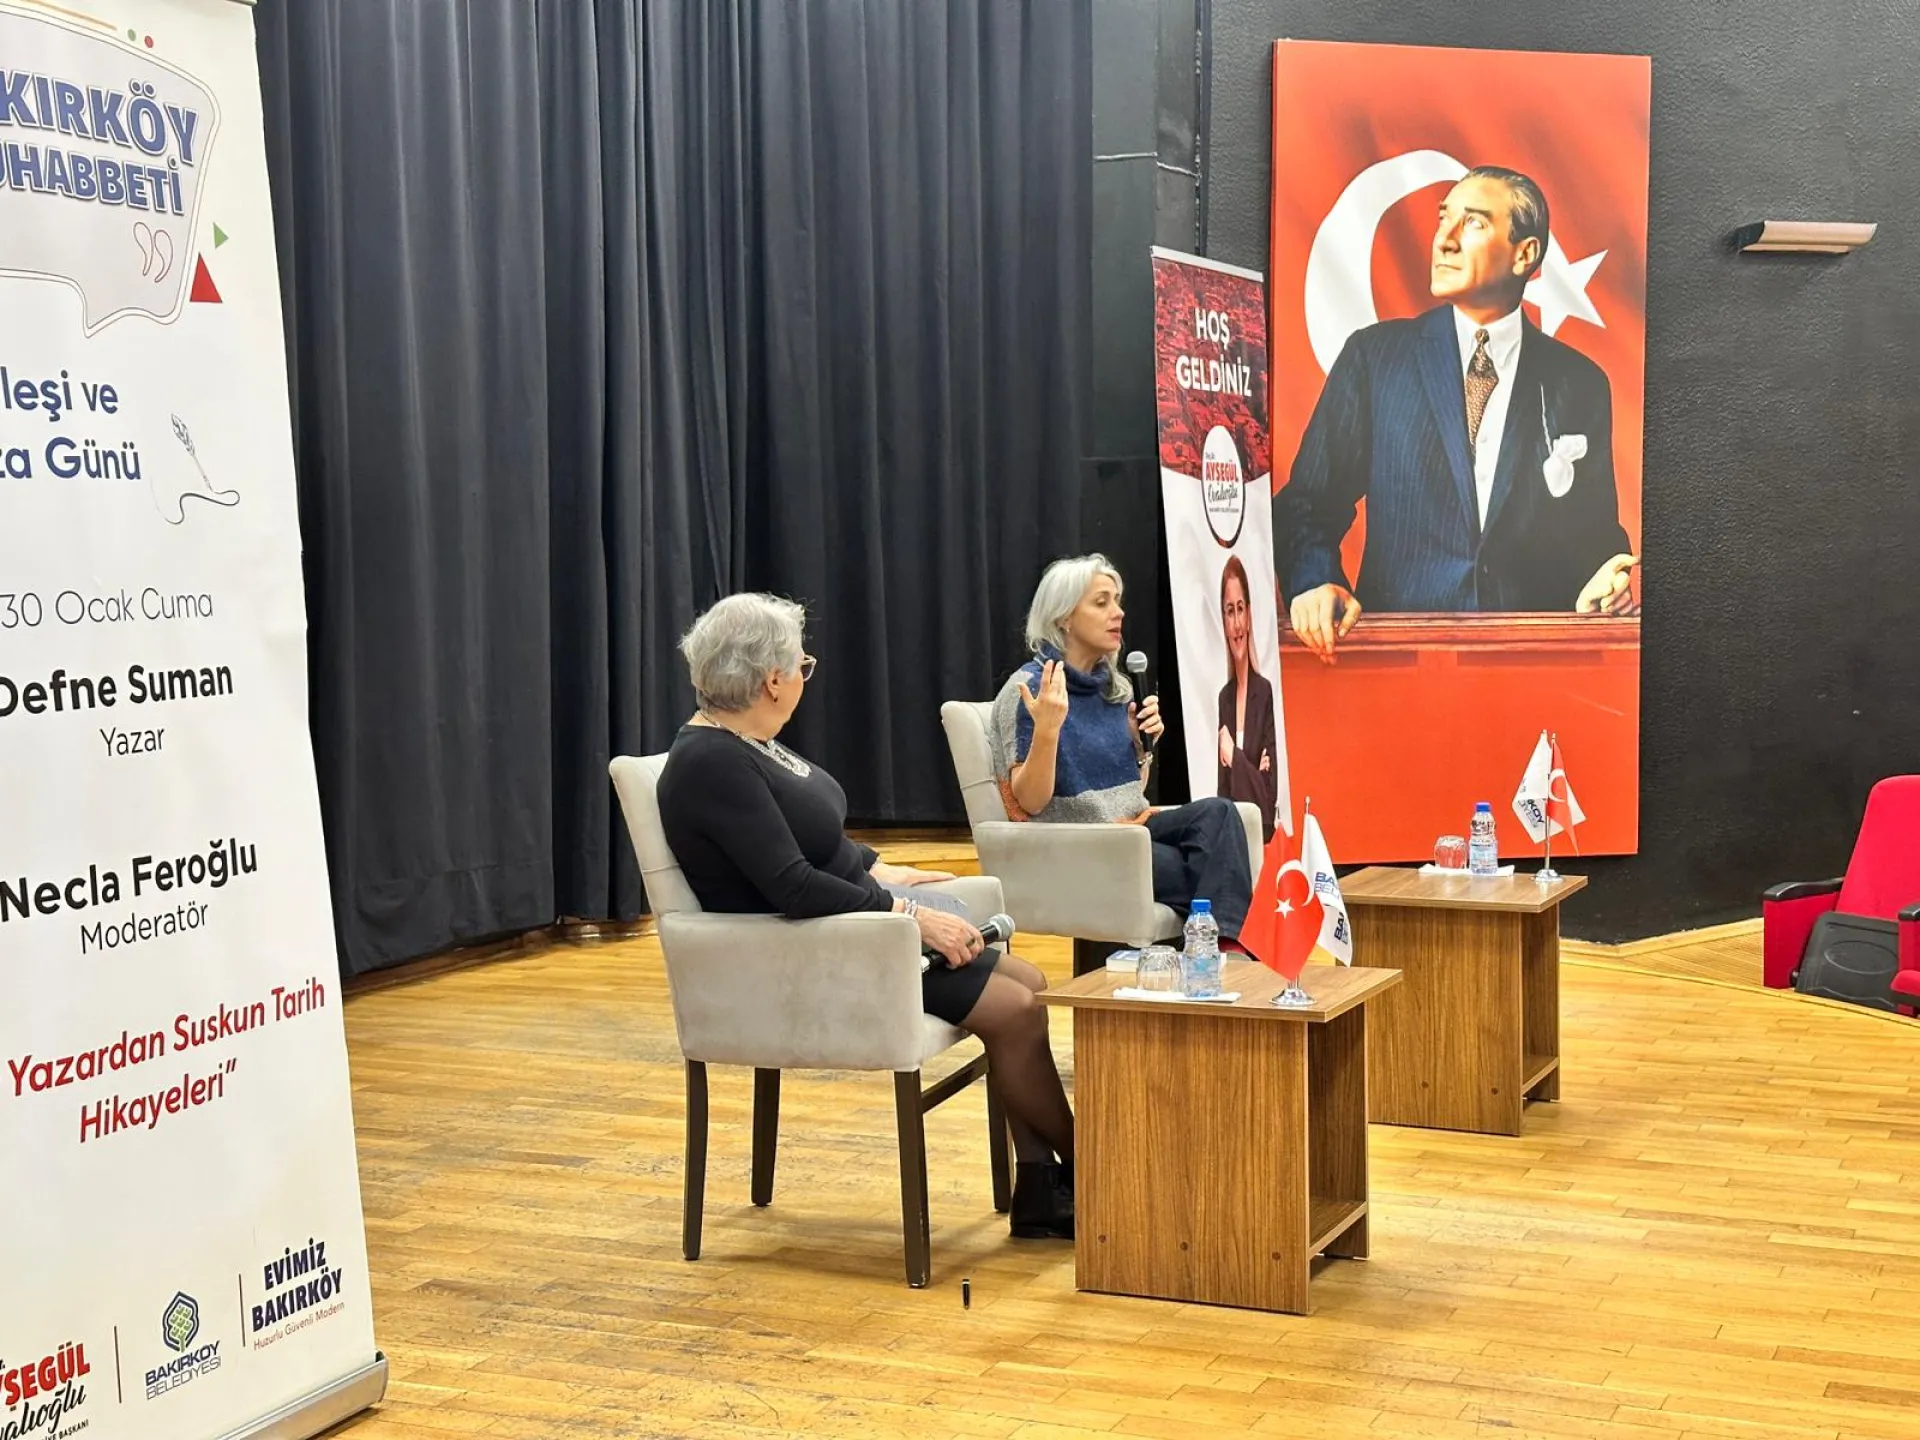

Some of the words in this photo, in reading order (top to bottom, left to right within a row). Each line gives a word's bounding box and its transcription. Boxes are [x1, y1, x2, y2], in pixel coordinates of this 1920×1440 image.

[0, 70, 198, 165] KIRKÖY
[0, 141, 184, 215] HABBETİ
[1194, 307, 1230, 350] HOŞ
[0, 365, 72, 422] leşi
[81, 382, 119, 414] ve
[1176, 353, 1252, 397] GELDİNİZ
[45, 436, 141, 480] Günü
[0, 591, 42, 628] 30
[55, 588, 134, 625] Ocak
[141, 587, 214, 620] Cuma
[128, 664, 233, 704] Suman
[100, 727, 165, 757] Yazar
[0, 864, 120, 922] Necla
[132, 837, 258, 896] Feroğlu
[80, 900, 208, 954] Moderatör
[8, 1030, 165, 1097] Yazardan
[173, 1003, 265, 1051] Suskun
[271, 976, 325, 1024] Tarih
[264, 1237, 326, 1290] EVİMİZ
[252, 1266, 342, 1332] BAKIRKÖY
[253, 1330, 284, 1351] Huzurlu
[285, 1313, 314, 1336] Güvenli
[315, 1301, 345, 1322] Modern
[0, 1340, 90, 1412] ŞEGÜL
